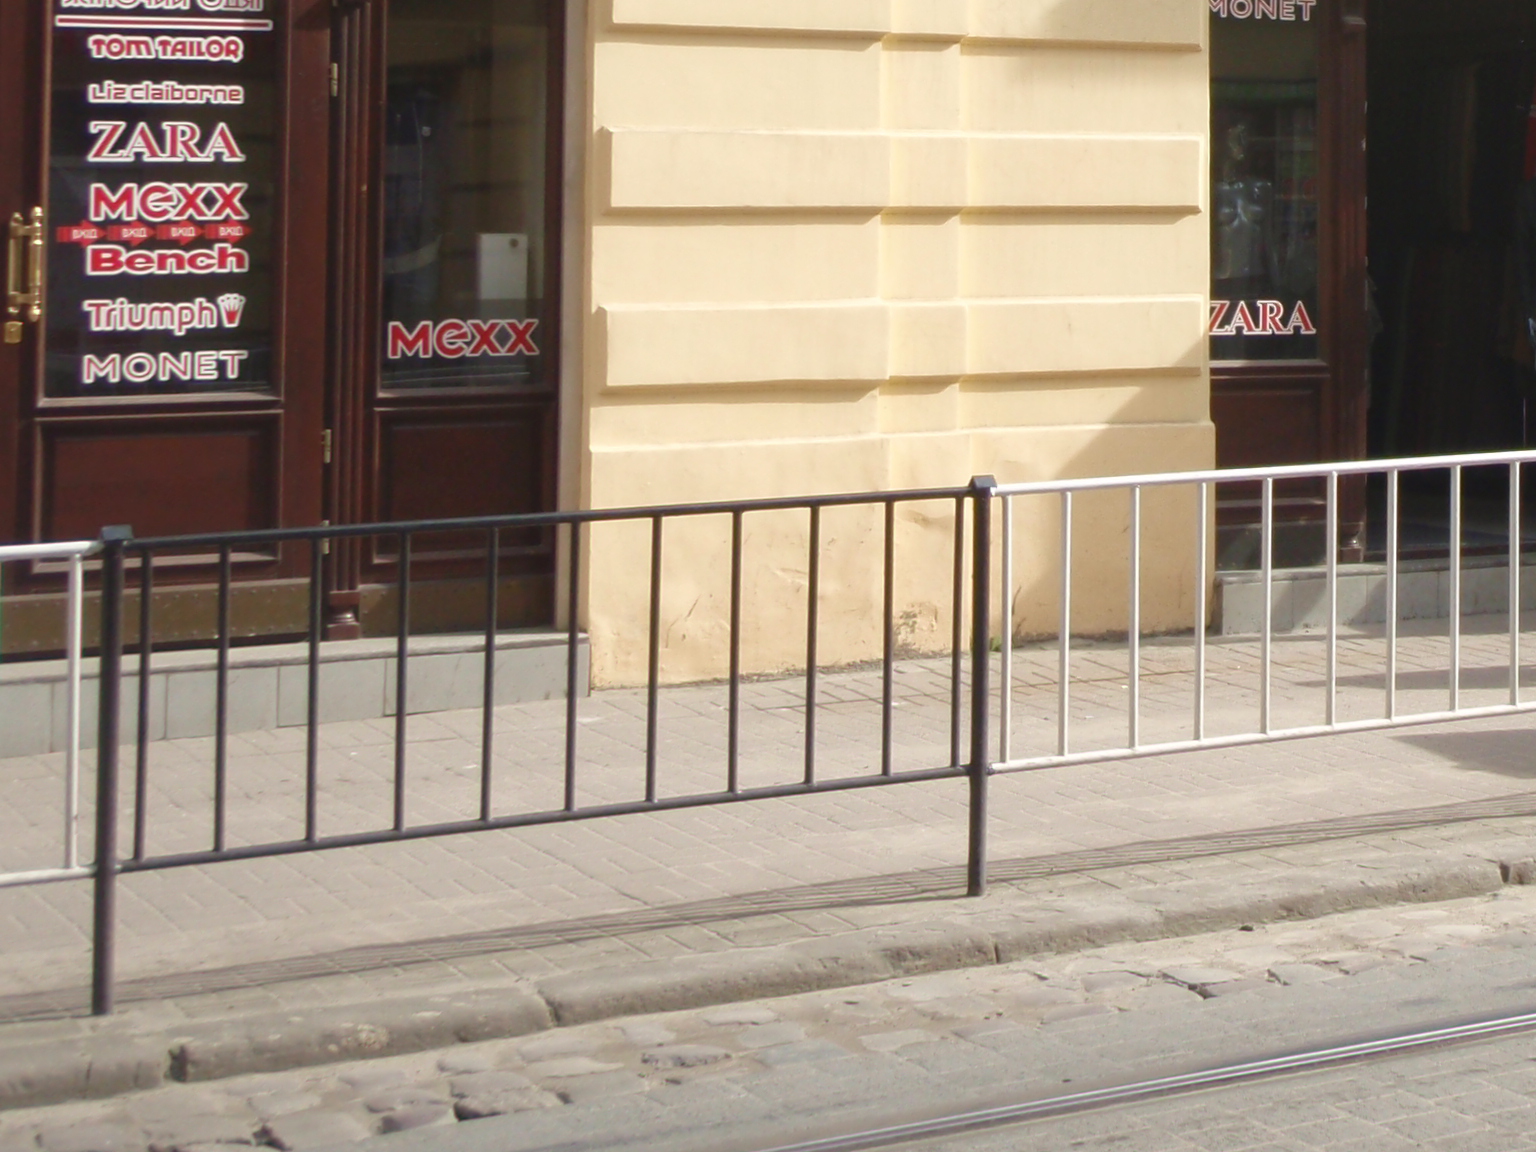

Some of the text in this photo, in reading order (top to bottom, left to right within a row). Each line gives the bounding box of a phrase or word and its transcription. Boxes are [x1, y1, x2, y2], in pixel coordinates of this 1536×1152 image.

[154, 35, 243, 63] TAILOR
[87, 121, 245, 163] ZARA
[86, 244, 248, 275] Bench
[83, 298, 217, 335] Triumph
[1209, 300, 1316, 336] ZARA
[82, 350, 248, 384] MONET
